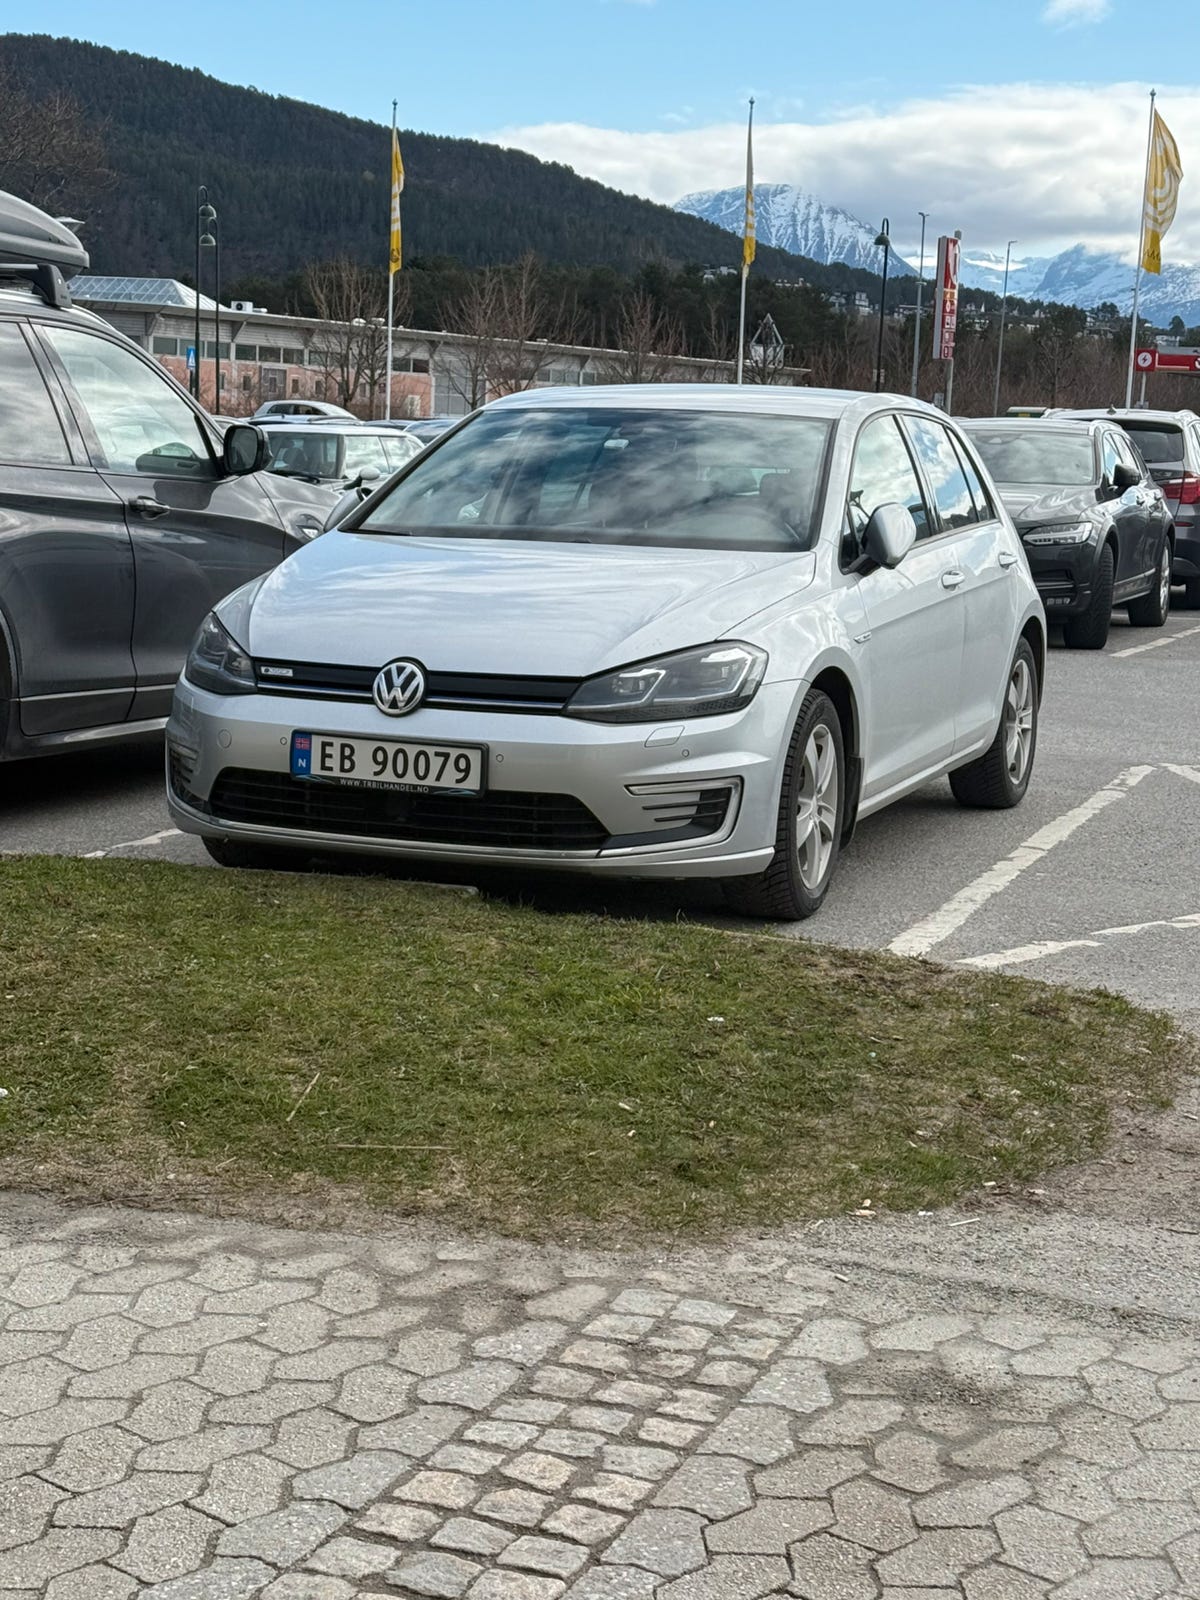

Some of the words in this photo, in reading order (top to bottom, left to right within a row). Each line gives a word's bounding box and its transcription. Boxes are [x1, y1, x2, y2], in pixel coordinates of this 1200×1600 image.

[374, 662, 424, 713] VW
[298, 758, 307, 768] N
[320, 740, 355, 774] EB
[371, 745, 472, 784] 90079
